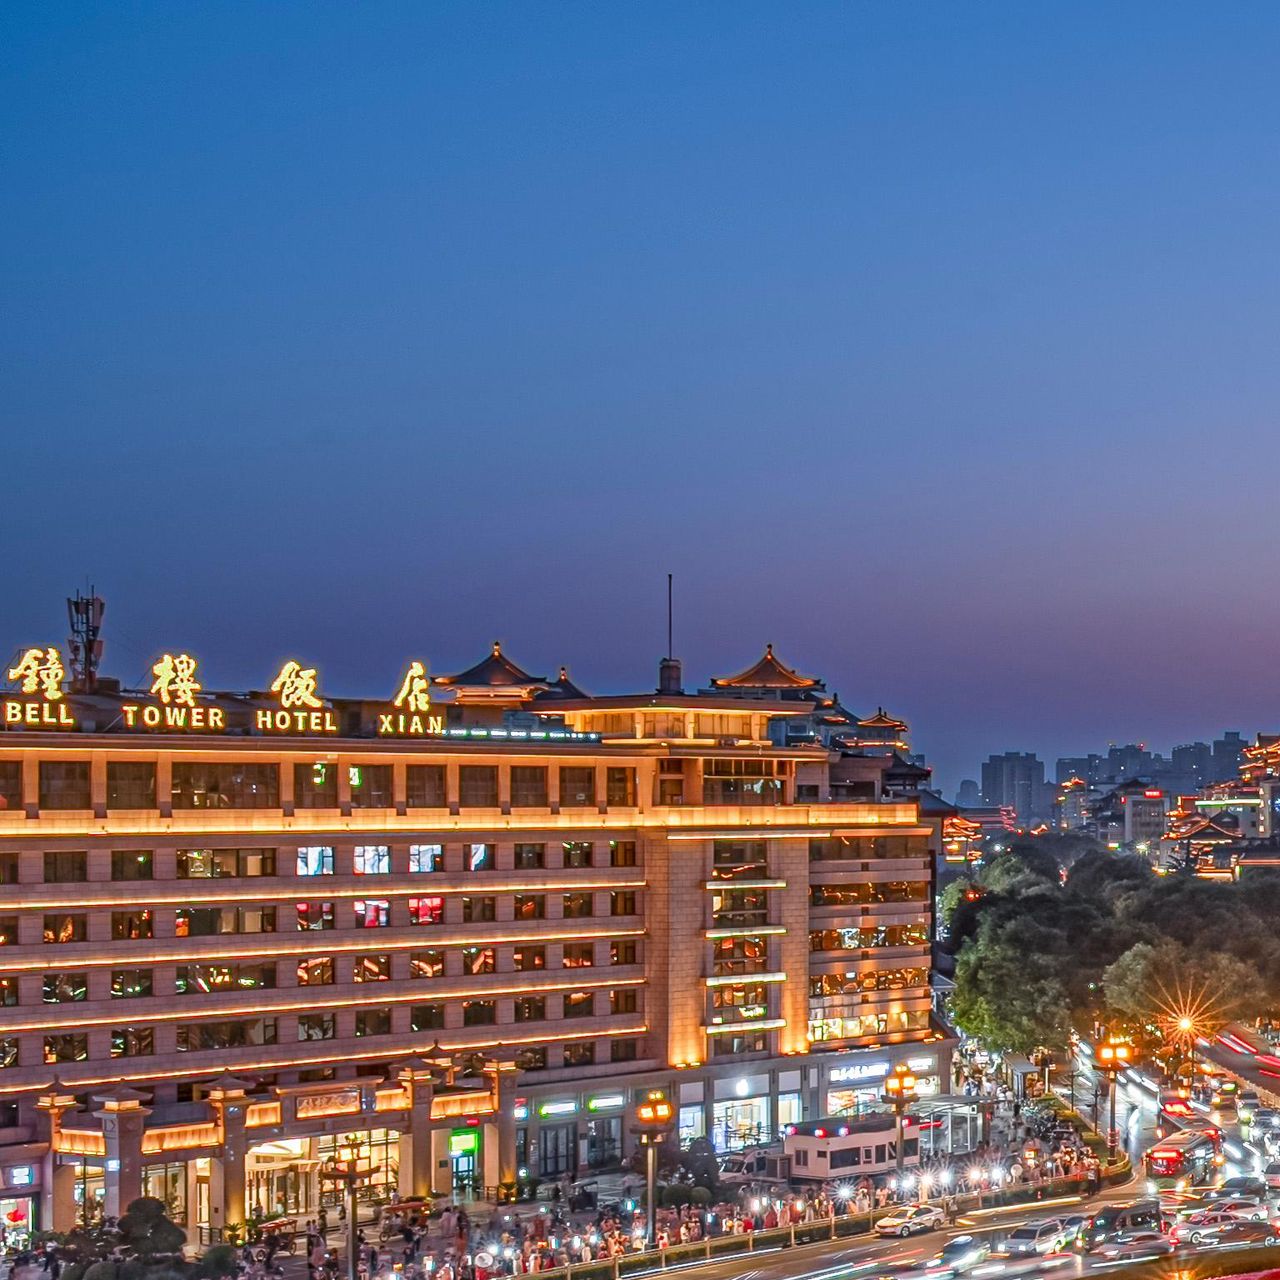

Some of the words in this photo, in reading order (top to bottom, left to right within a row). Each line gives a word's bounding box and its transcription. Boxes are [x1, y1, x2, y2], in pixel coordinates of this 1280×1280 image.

[6, 702, 74, 725] BELL
[122, 706, 224, 727] TOWER
[256, 710, 337, 731] HOTEL
[379, 714, 444, 734] XIAN
